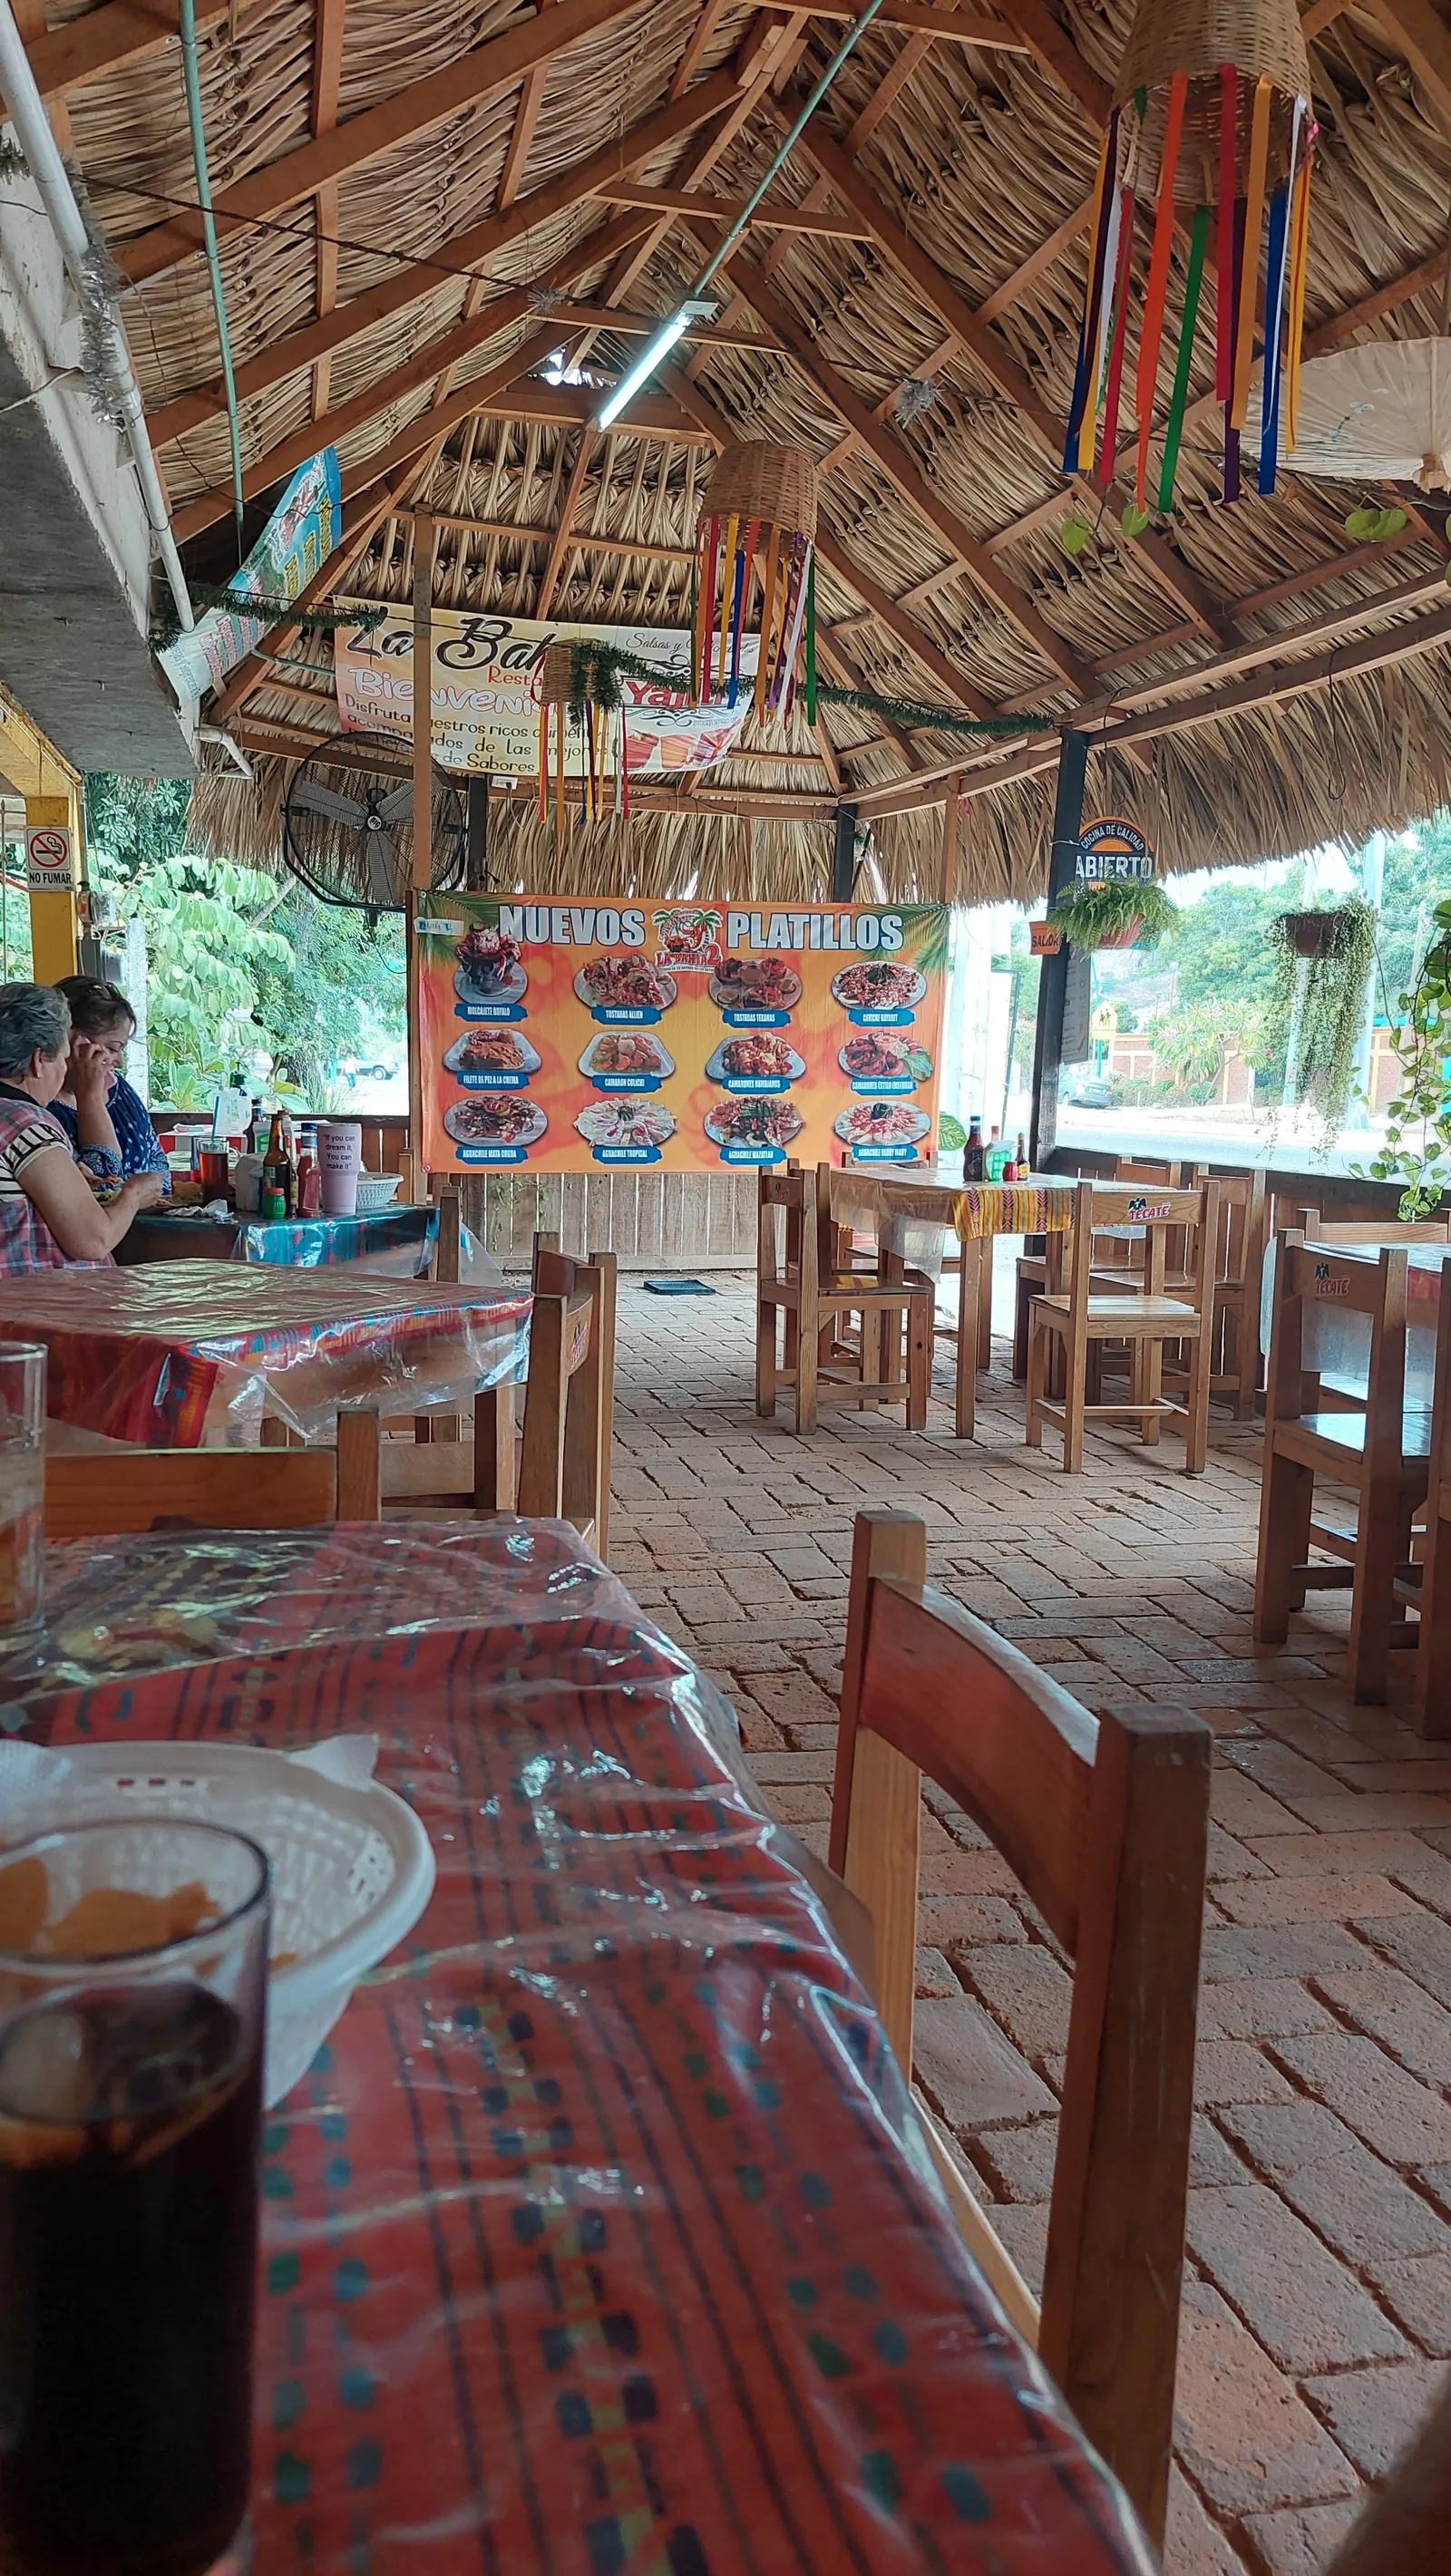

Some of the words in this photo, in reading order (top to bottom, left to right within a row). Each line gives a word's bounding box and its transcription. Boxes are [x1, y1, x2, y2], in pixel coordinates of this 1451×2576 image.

[626, 633, 671, 649] Salsas
[346, 694, 412, 724] Disfruta
[490, 723, 532, 738] ricos
[475, 737, 495, 753] de
[506, 739, 531, 755] las
[467, 753, 535, 773] Sabores
[1081, 825, 1105, 849] COCINA
[1106, 825, 1115, 835] DE
[1116, 826, 1144, 851] CALIDAD
[1076, 855, 1153, 879] ABIERTO
[29, 872, 41, 883] NO
[43, 872, 72, 884] FUMAR
[499, 905, 647, 947] NUEVOS
[727, 911, 903, 951] PLATILLOS
[705, 944, 720, 966] 2
[1128, 1206, 1170, 1221] TECATE
[1317, 1279, 1349, 1295] TECATE
